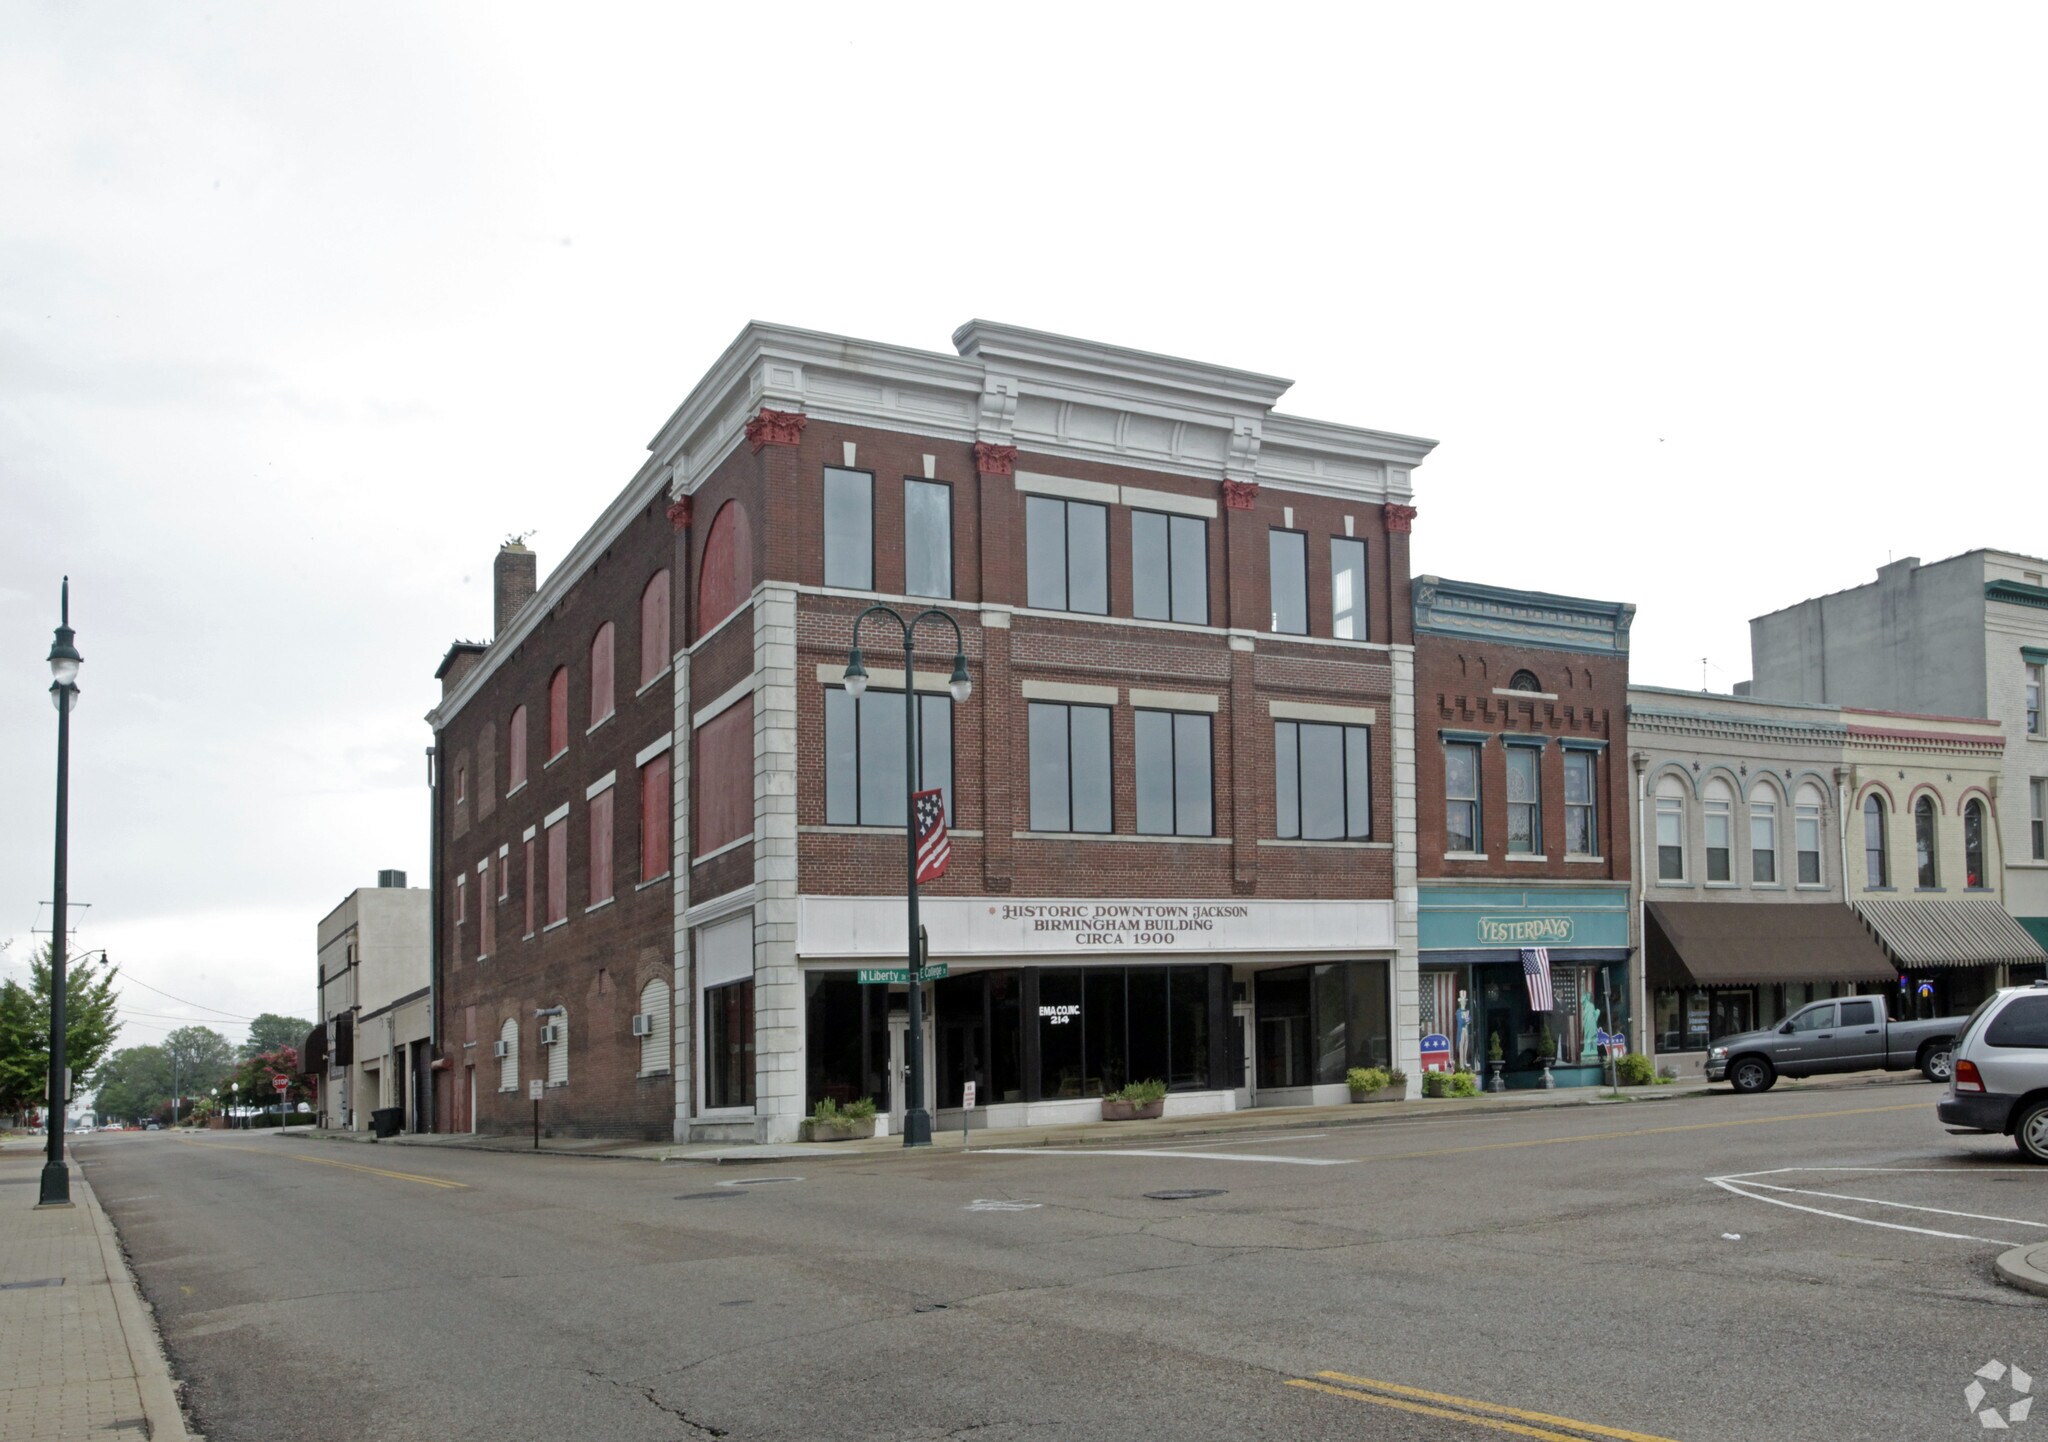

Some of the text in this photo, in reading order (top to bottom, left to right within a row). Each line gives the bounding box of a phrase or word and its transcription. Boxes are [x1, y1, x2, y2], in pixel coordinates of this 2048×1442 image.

[1002, 905, 1248, 920] HISTORIC DOWNTOWN JACKSON
[1034, 919, 1213, 931] BIRMINGHAM BUILDING
[1481, 919, 1570, 940] YESTERDAYS
[1075, 933, 1175, 945] CIRCA 1900
[861, 970, 867, 981] N
[869, 970, 898, 982] Liberty
[920, 968, 924, 978] E
[924, 966, 942, 978] College
[1039, 1006, 1056, 1016] EMA
[1050, 1015, 1069, 1024] 214
